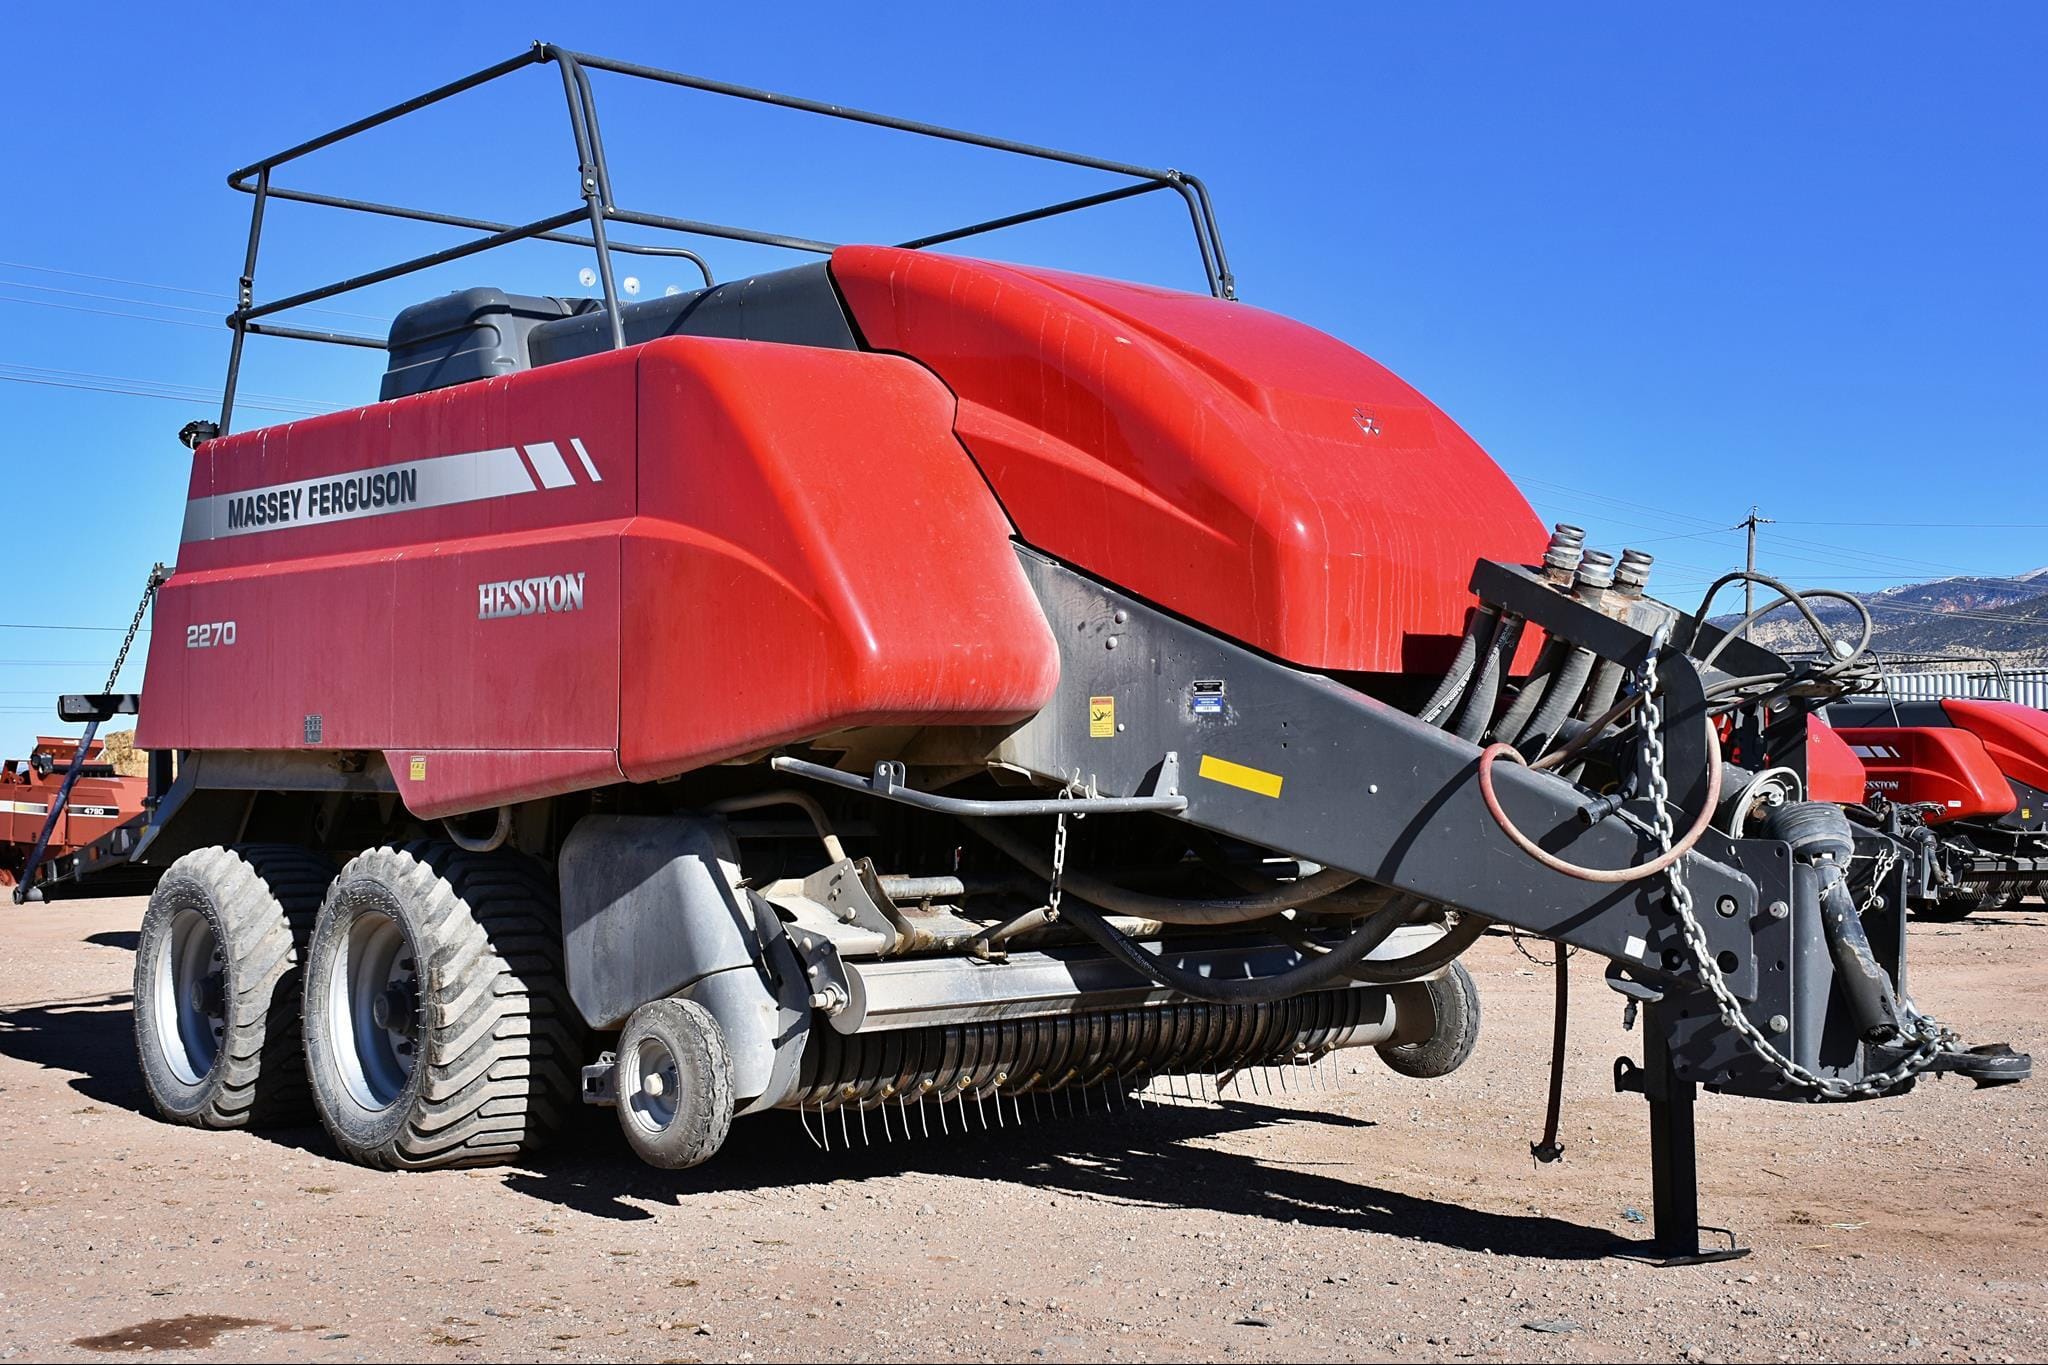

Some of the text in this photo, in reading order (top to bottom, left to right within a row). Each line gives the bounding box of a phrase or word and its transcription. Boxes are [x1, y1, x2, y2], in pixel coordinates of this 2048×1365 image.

[228, 468, 417, 529] MASSEY FERGUSON
[478, 571, 585, 620] HESSTON
[187, 621, 236, 648] 2270
[1864, 780, 1899, 790] ESSTON
